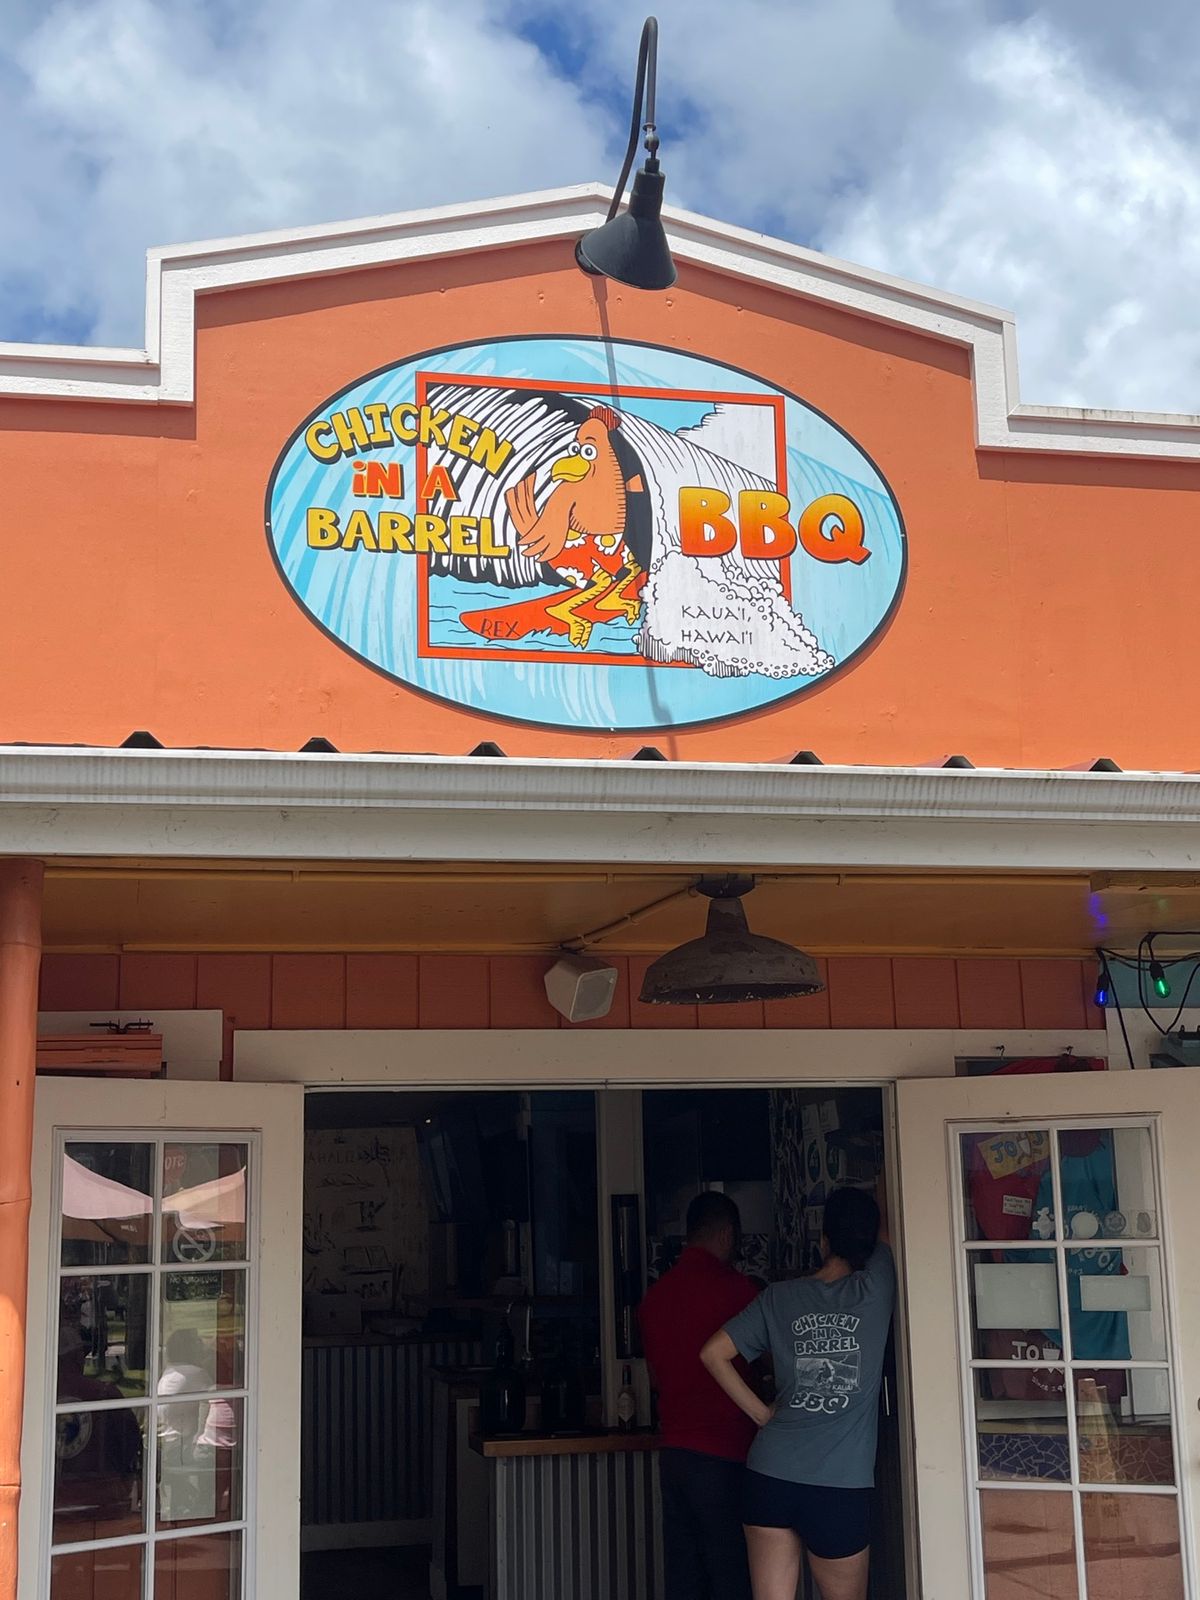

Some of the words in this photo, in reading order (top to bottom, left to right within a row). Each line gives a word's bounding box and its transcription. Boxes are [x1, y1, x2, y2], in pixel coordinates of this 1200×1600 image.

[305, 403, 516, 480] CHICKEN
[420, 464, 461, 501] A
[307, 507, 512, 559] BARREL
[678, 486, 872, 566] BBQ
[481, 618, 520, 638] REX
[681, 629, 752, 645] HAWAI'I
[829, 1328, 842, 1339] A
[794, 1336, 860, 1356] BARREL
[789, 1391, 850, 1414] BBQ
